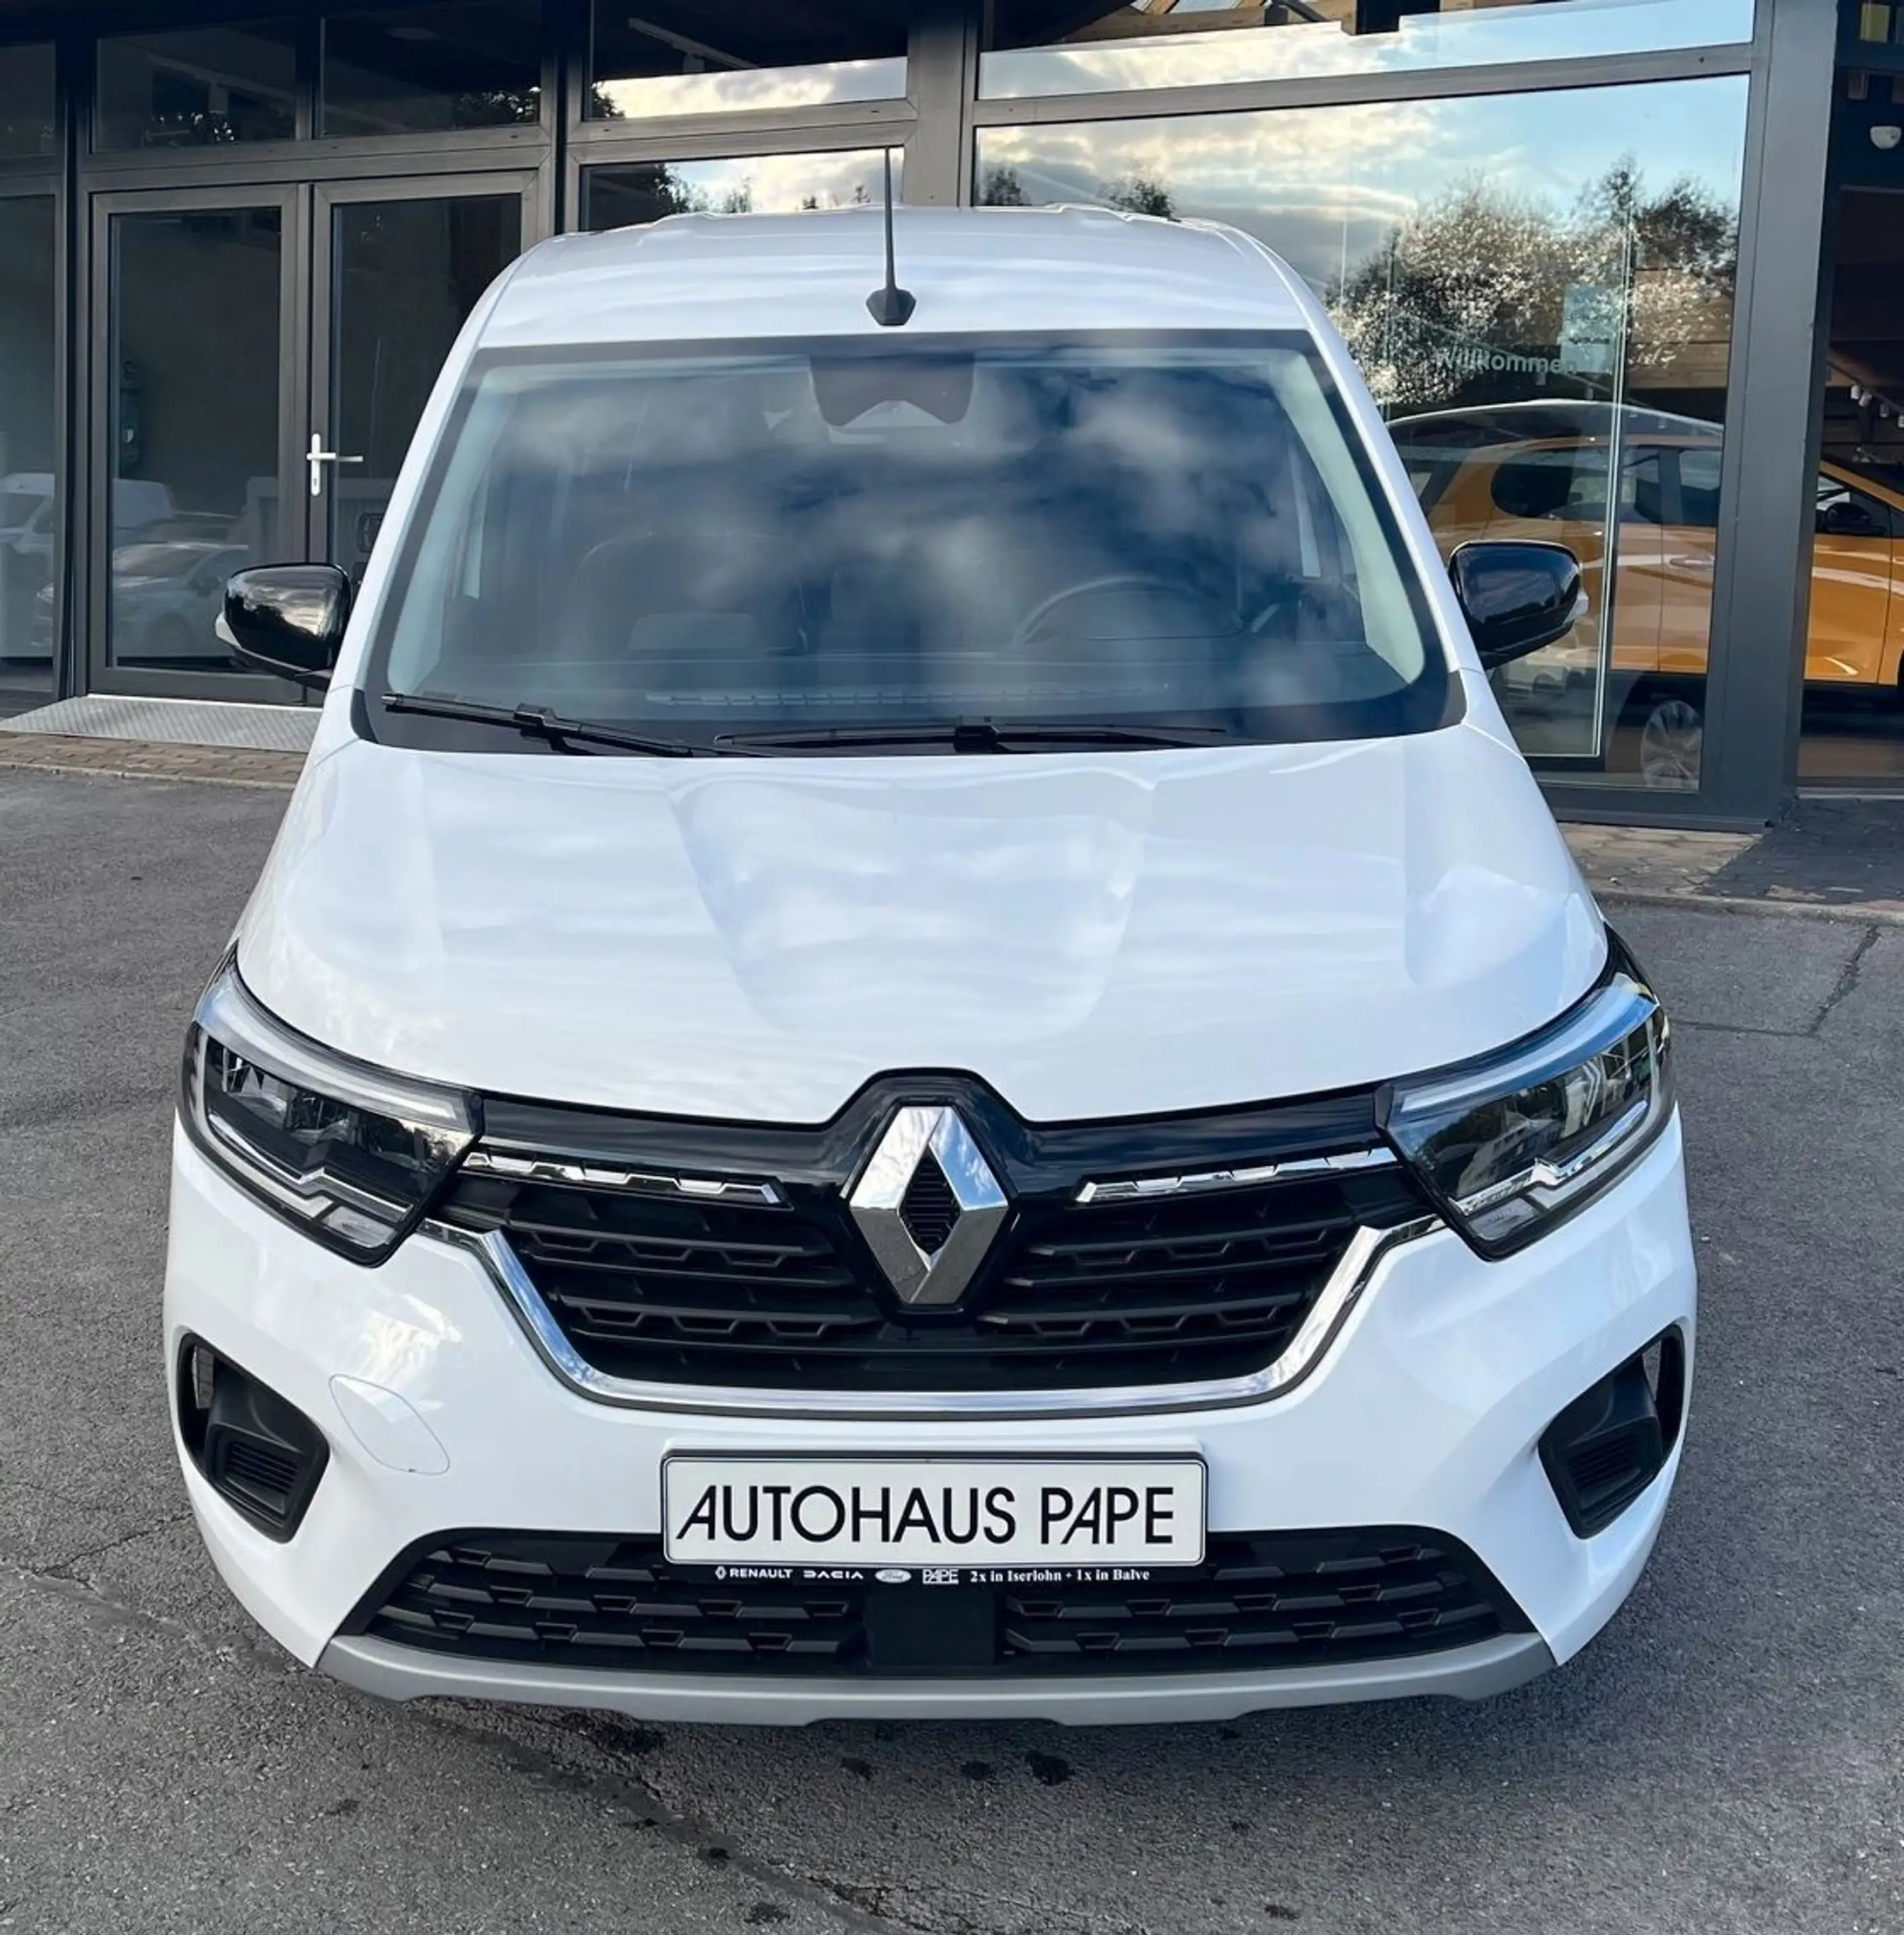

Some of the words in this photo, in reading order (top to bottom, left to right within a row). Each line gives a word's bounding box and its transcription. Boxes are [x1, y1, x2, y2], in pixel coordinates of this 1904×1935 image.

[675, 1484, 1016, 1545] AUTOHAUS
[1041, 1486, 1174, 1545] PAPE
[730, 1568, 793, 1580] RENAULT
[804, 1570, 864, 1580] DACIA
[922, 1568, 959, 1584] PAPE
[970, 1570, 986, 1583] 2x
[990, 1570, 1003, 1582] in
[1007, 1570, 1062, 1582] Iserlohn
[1077, 1569, 1092, 1581] 1x
[1096, 1569, 1109, 1580] in
[1113, 1568, 1150, 1581] Balve
